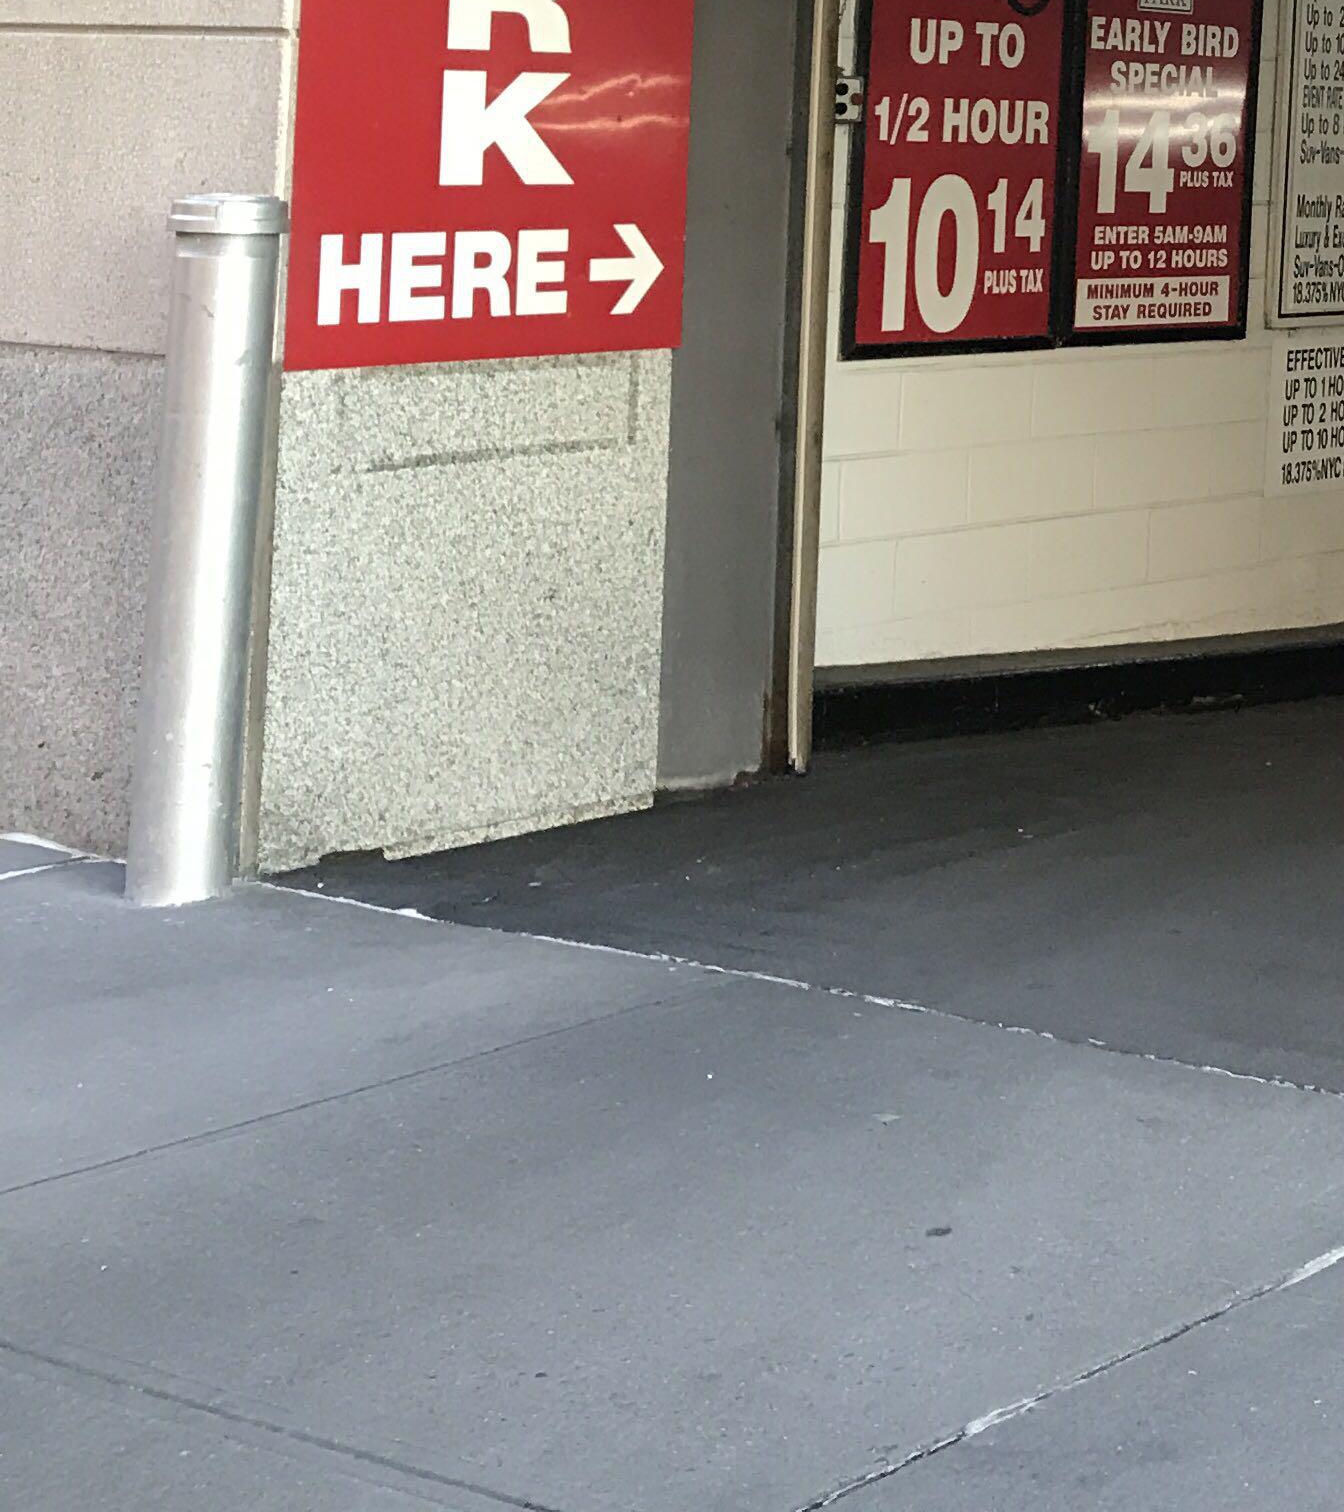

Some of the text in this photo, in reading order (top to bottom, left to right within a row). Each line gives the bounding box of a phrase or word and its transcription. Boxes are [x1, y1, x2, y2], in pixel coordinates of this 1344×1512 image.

[1307, 4, 1320, 29] Up
[1323, 6, 1333, 27] to
[910, 18, 1025, 68] UP TO
[1090, 16, 1239, 58] EARLY BIRD
[1305, 31, 1318, 57] Up
[1322, 34, 1332, 54] to
[1111, 60, 1217, 99] SPECIAL
[1304, 58, 1317, 84] Up
[1321, 60, 1331, 81] to
[1334, 60, 1344, 82] 24
[875, 93, 1049, 145] 1/2 HOUR
[1302, 113, 1315, 139] Up
[1319, 114, 1329, 135] to
[1333, 114, 1340, 135] 8
[1087, 109, 1237, 213] 14 36
[1180, 171, 1234, 188] PLUS TAX
[1297, 194, 1332, 223] Monthly
[1094, 225, 1227, 245] ENTER 5AM-9AM
[869, 174, 1045, 333] 10 14
[1091, 249, 1228, 270] UP TO 12 HOURS
[317, 229, 570, 326] HERE
[984, 269, 1043, 295] PLUS TAX
[1087, 281, 1219, 300] MINIMUM 4-HOUR
[1093, 302, 1212, 321] STAY REQUIRED
[1285, 379, 1300, 400] UP
[1304, 377, 1317, 399] TO
[1321, 377, 1326, 398] 1
[1283, 404, 1298, 426] UP
[1301, 402, 1314, 425] TO
[1319, 402, 1326, 423] 2
[1282, 430, 1298, 454] UP
[1301, 428, 1314, 451] TO
[1317, 428, 1328, 449] 10
